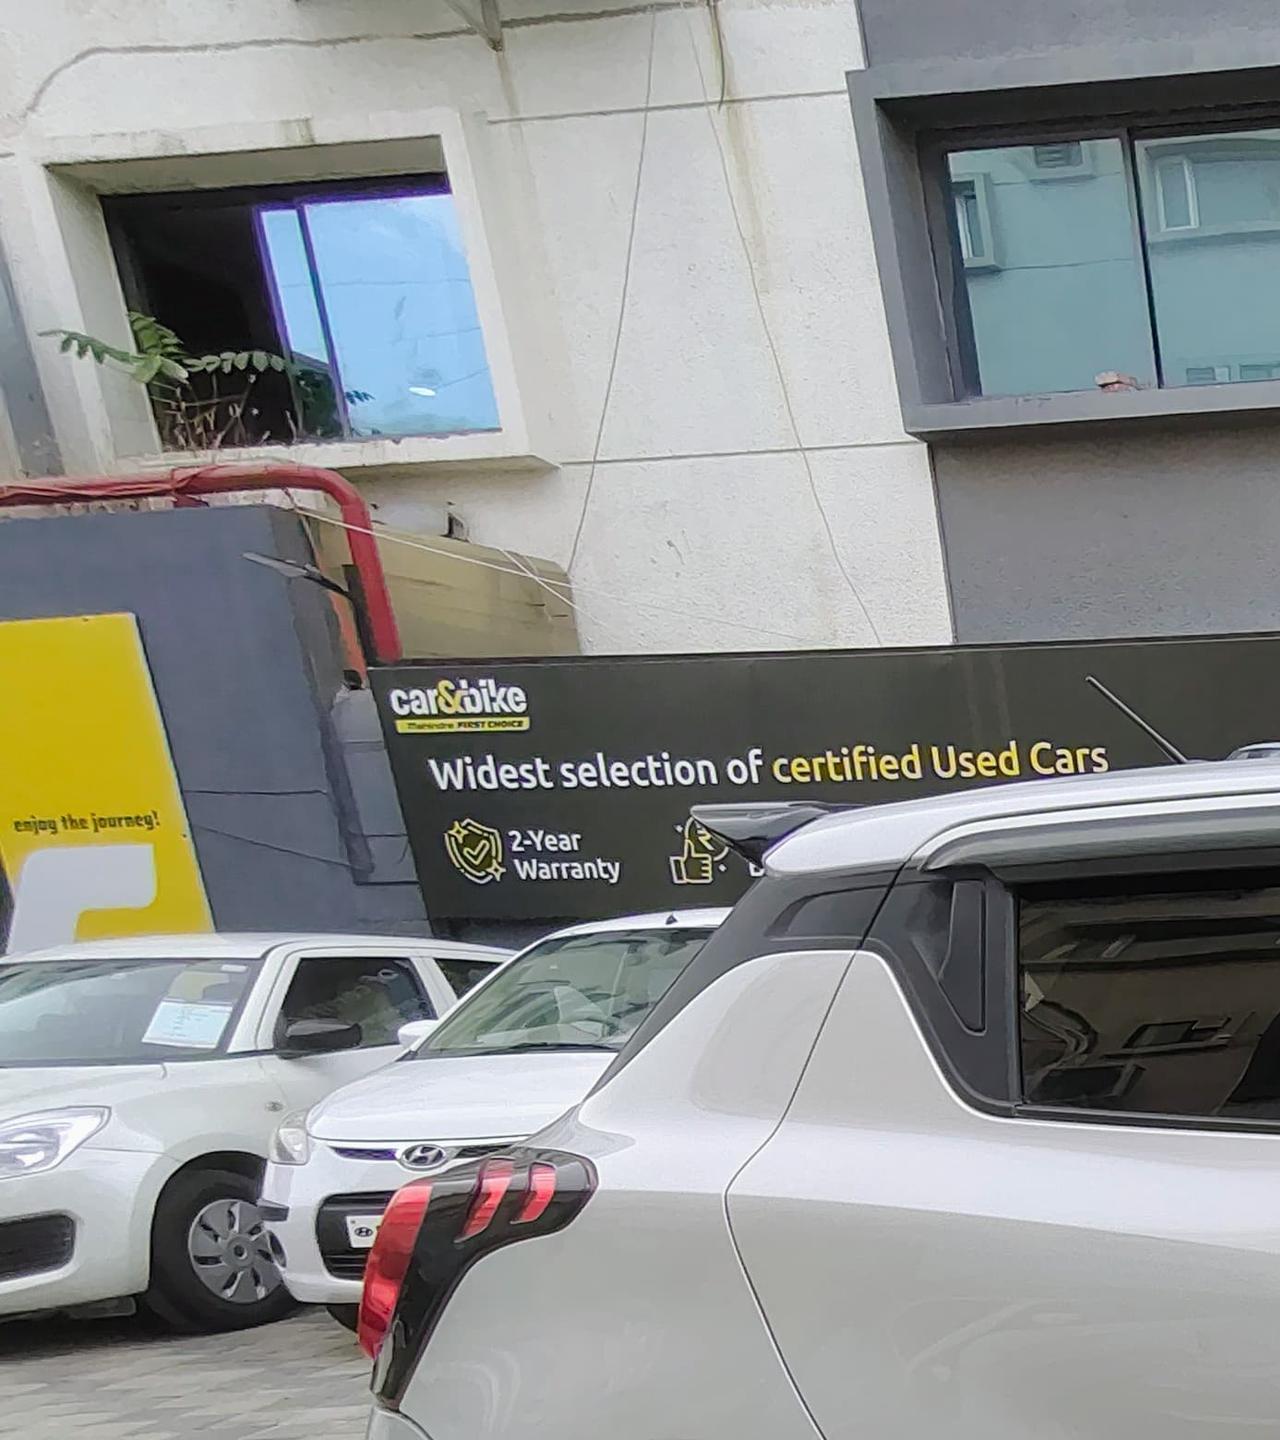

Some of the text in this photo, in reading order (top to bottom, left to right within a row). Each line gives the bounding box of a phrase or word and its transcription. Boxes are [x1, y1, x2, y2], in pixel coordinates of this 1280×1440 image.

[390, 678, 528, 716] car&bike
[428, 740, 1110, 790] Widest selection of certified Used Cars
[14, 810, 161, 834] enjoy the journey!
[508, 830, 582, 852] 2-Year
[514, 858, 621, 884] Warranty
